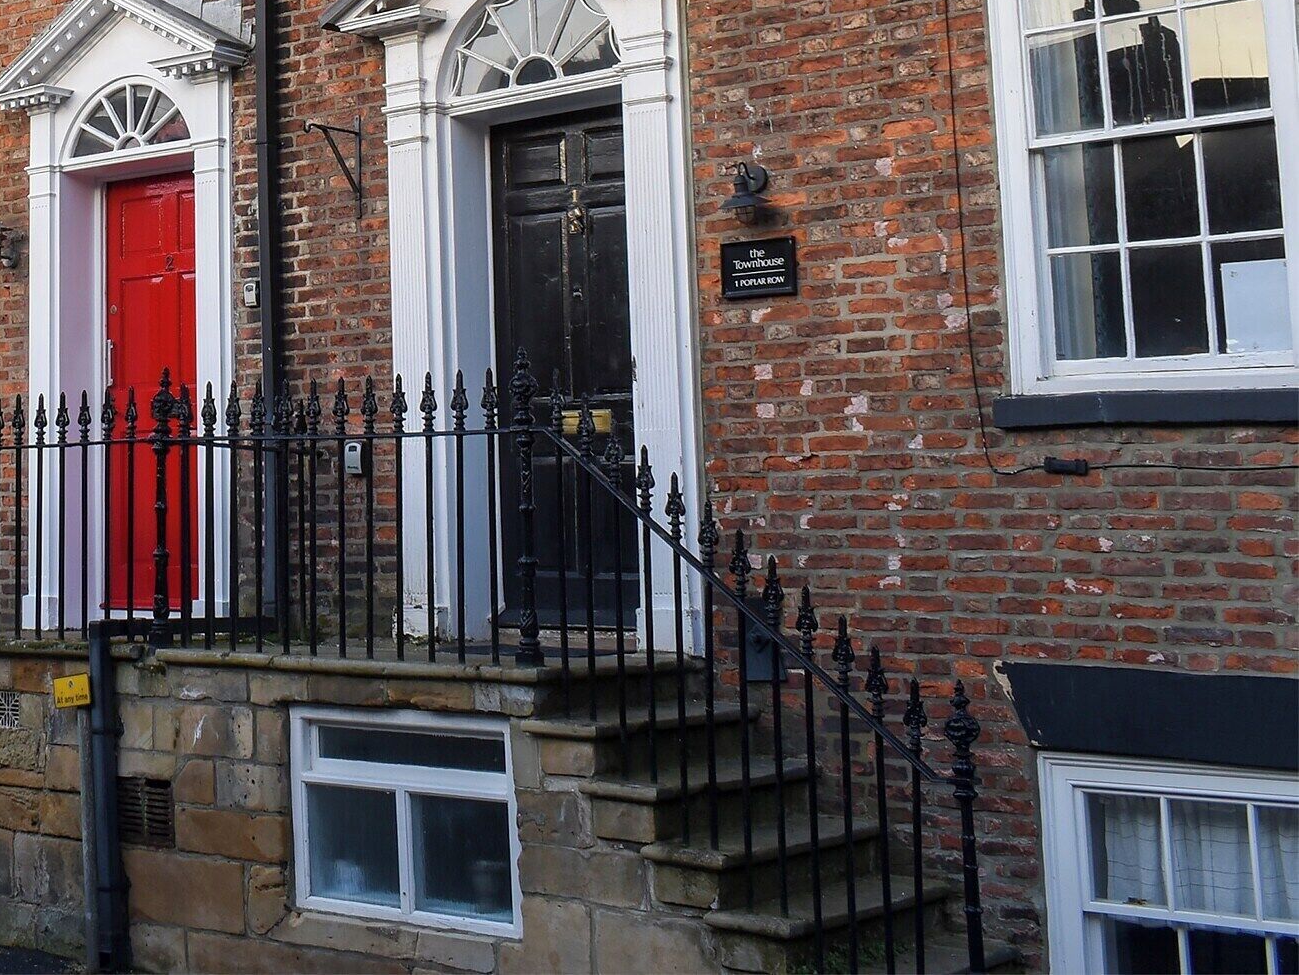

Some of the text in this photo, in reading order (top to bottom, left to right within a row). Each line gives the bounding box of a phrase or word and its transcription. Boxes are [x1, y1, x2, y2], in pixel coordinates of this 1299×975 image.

[749, 248, 765, 258] the
[165, 254, 174, 271] 2
[733, 257, 784, 270] Townhouse
[740, 277, 766, 287] POPLAR
[766, 275, 785, 285] ROW
